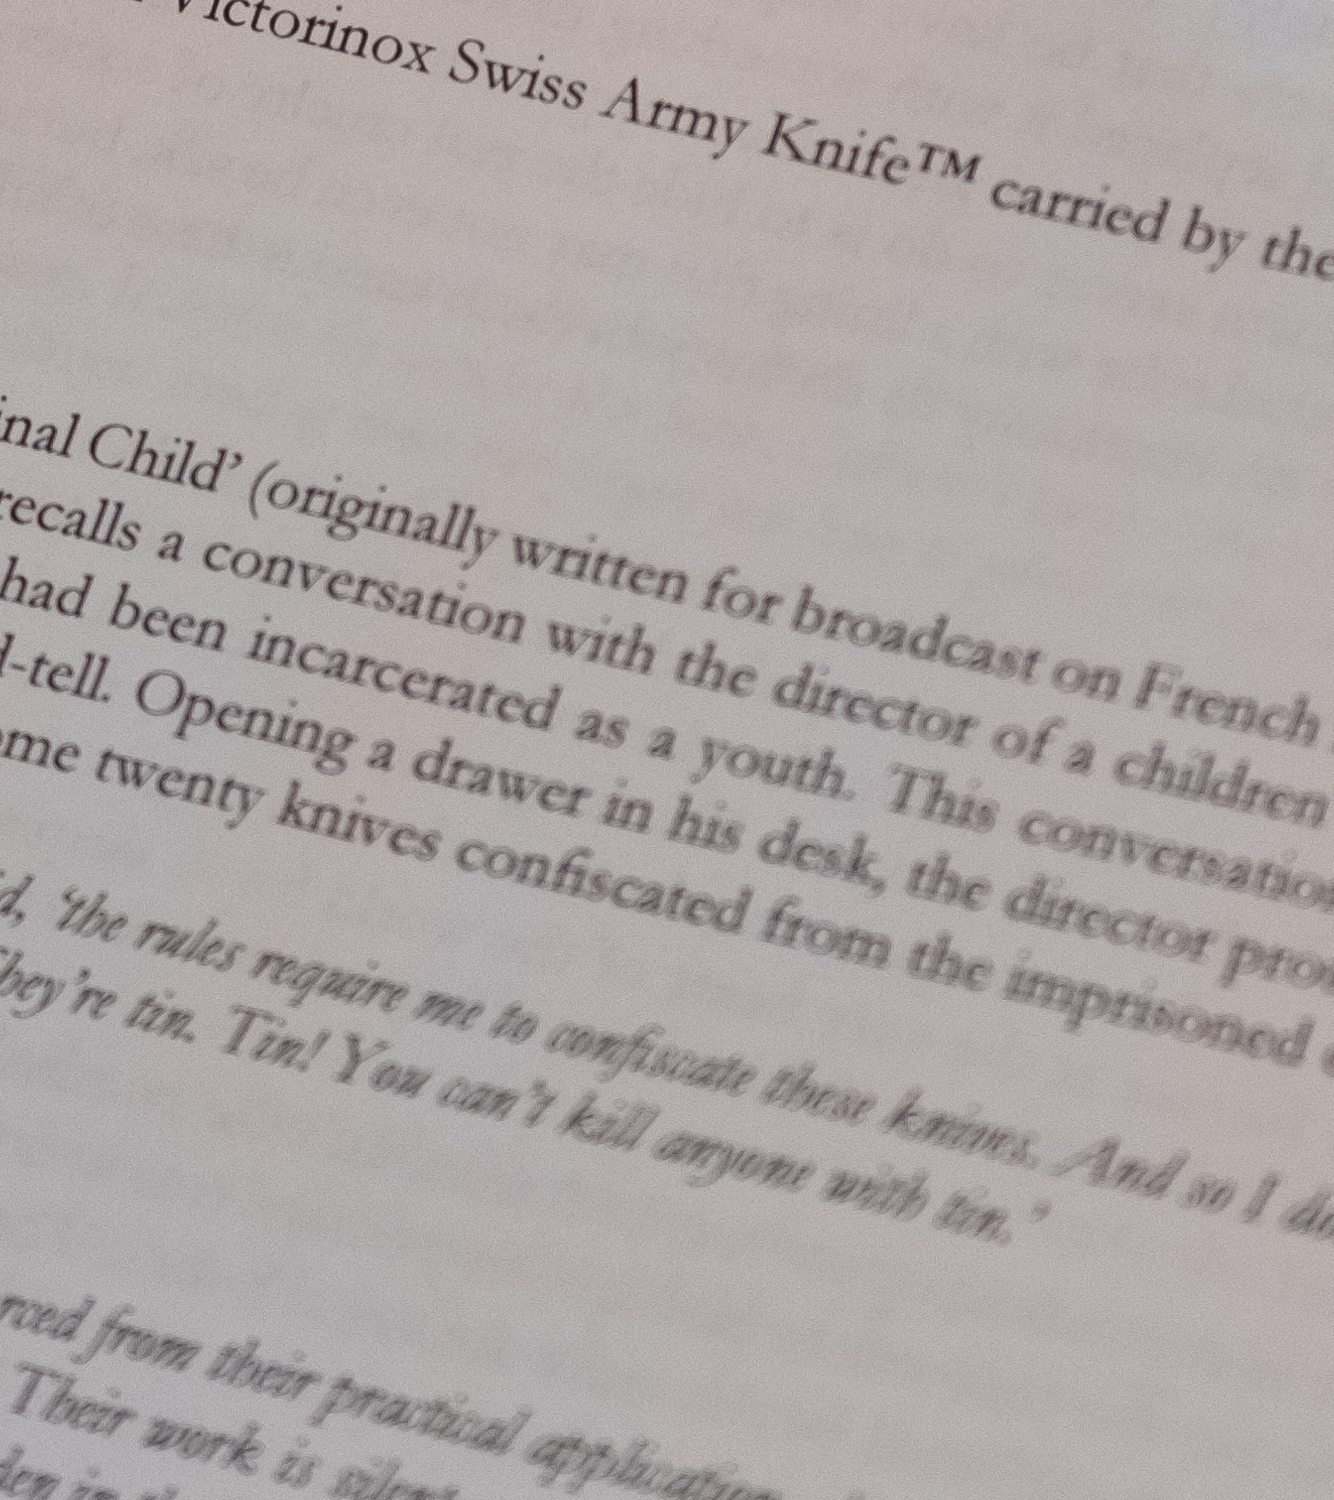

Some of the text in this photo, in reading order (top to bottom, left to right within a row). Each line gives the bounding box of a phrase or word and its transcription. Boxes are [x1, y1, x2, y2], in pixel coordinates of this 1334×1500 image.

[446, 36, 589, 112] Swiss
[597, 74, 752, 162] Army
[988, 178, 1173, 246] carried
[1178, 202, 1249, 275] by
[154, 529, 187, 565] a
[200, 540, 528, 646] conversation
[246, 459, 503, 573] (originally
[510, 532, 692, 607] written
[106, 579, 229, 654] been
[243, 613, 565, 734] incarcerated
[92, 746, 268, 832] twenty
[274, 776, 445, 864] knives
[132, 668, 360, 778] Opening
[364, 737, 398, 774] a
[408, 734, 595, 820] drawer
